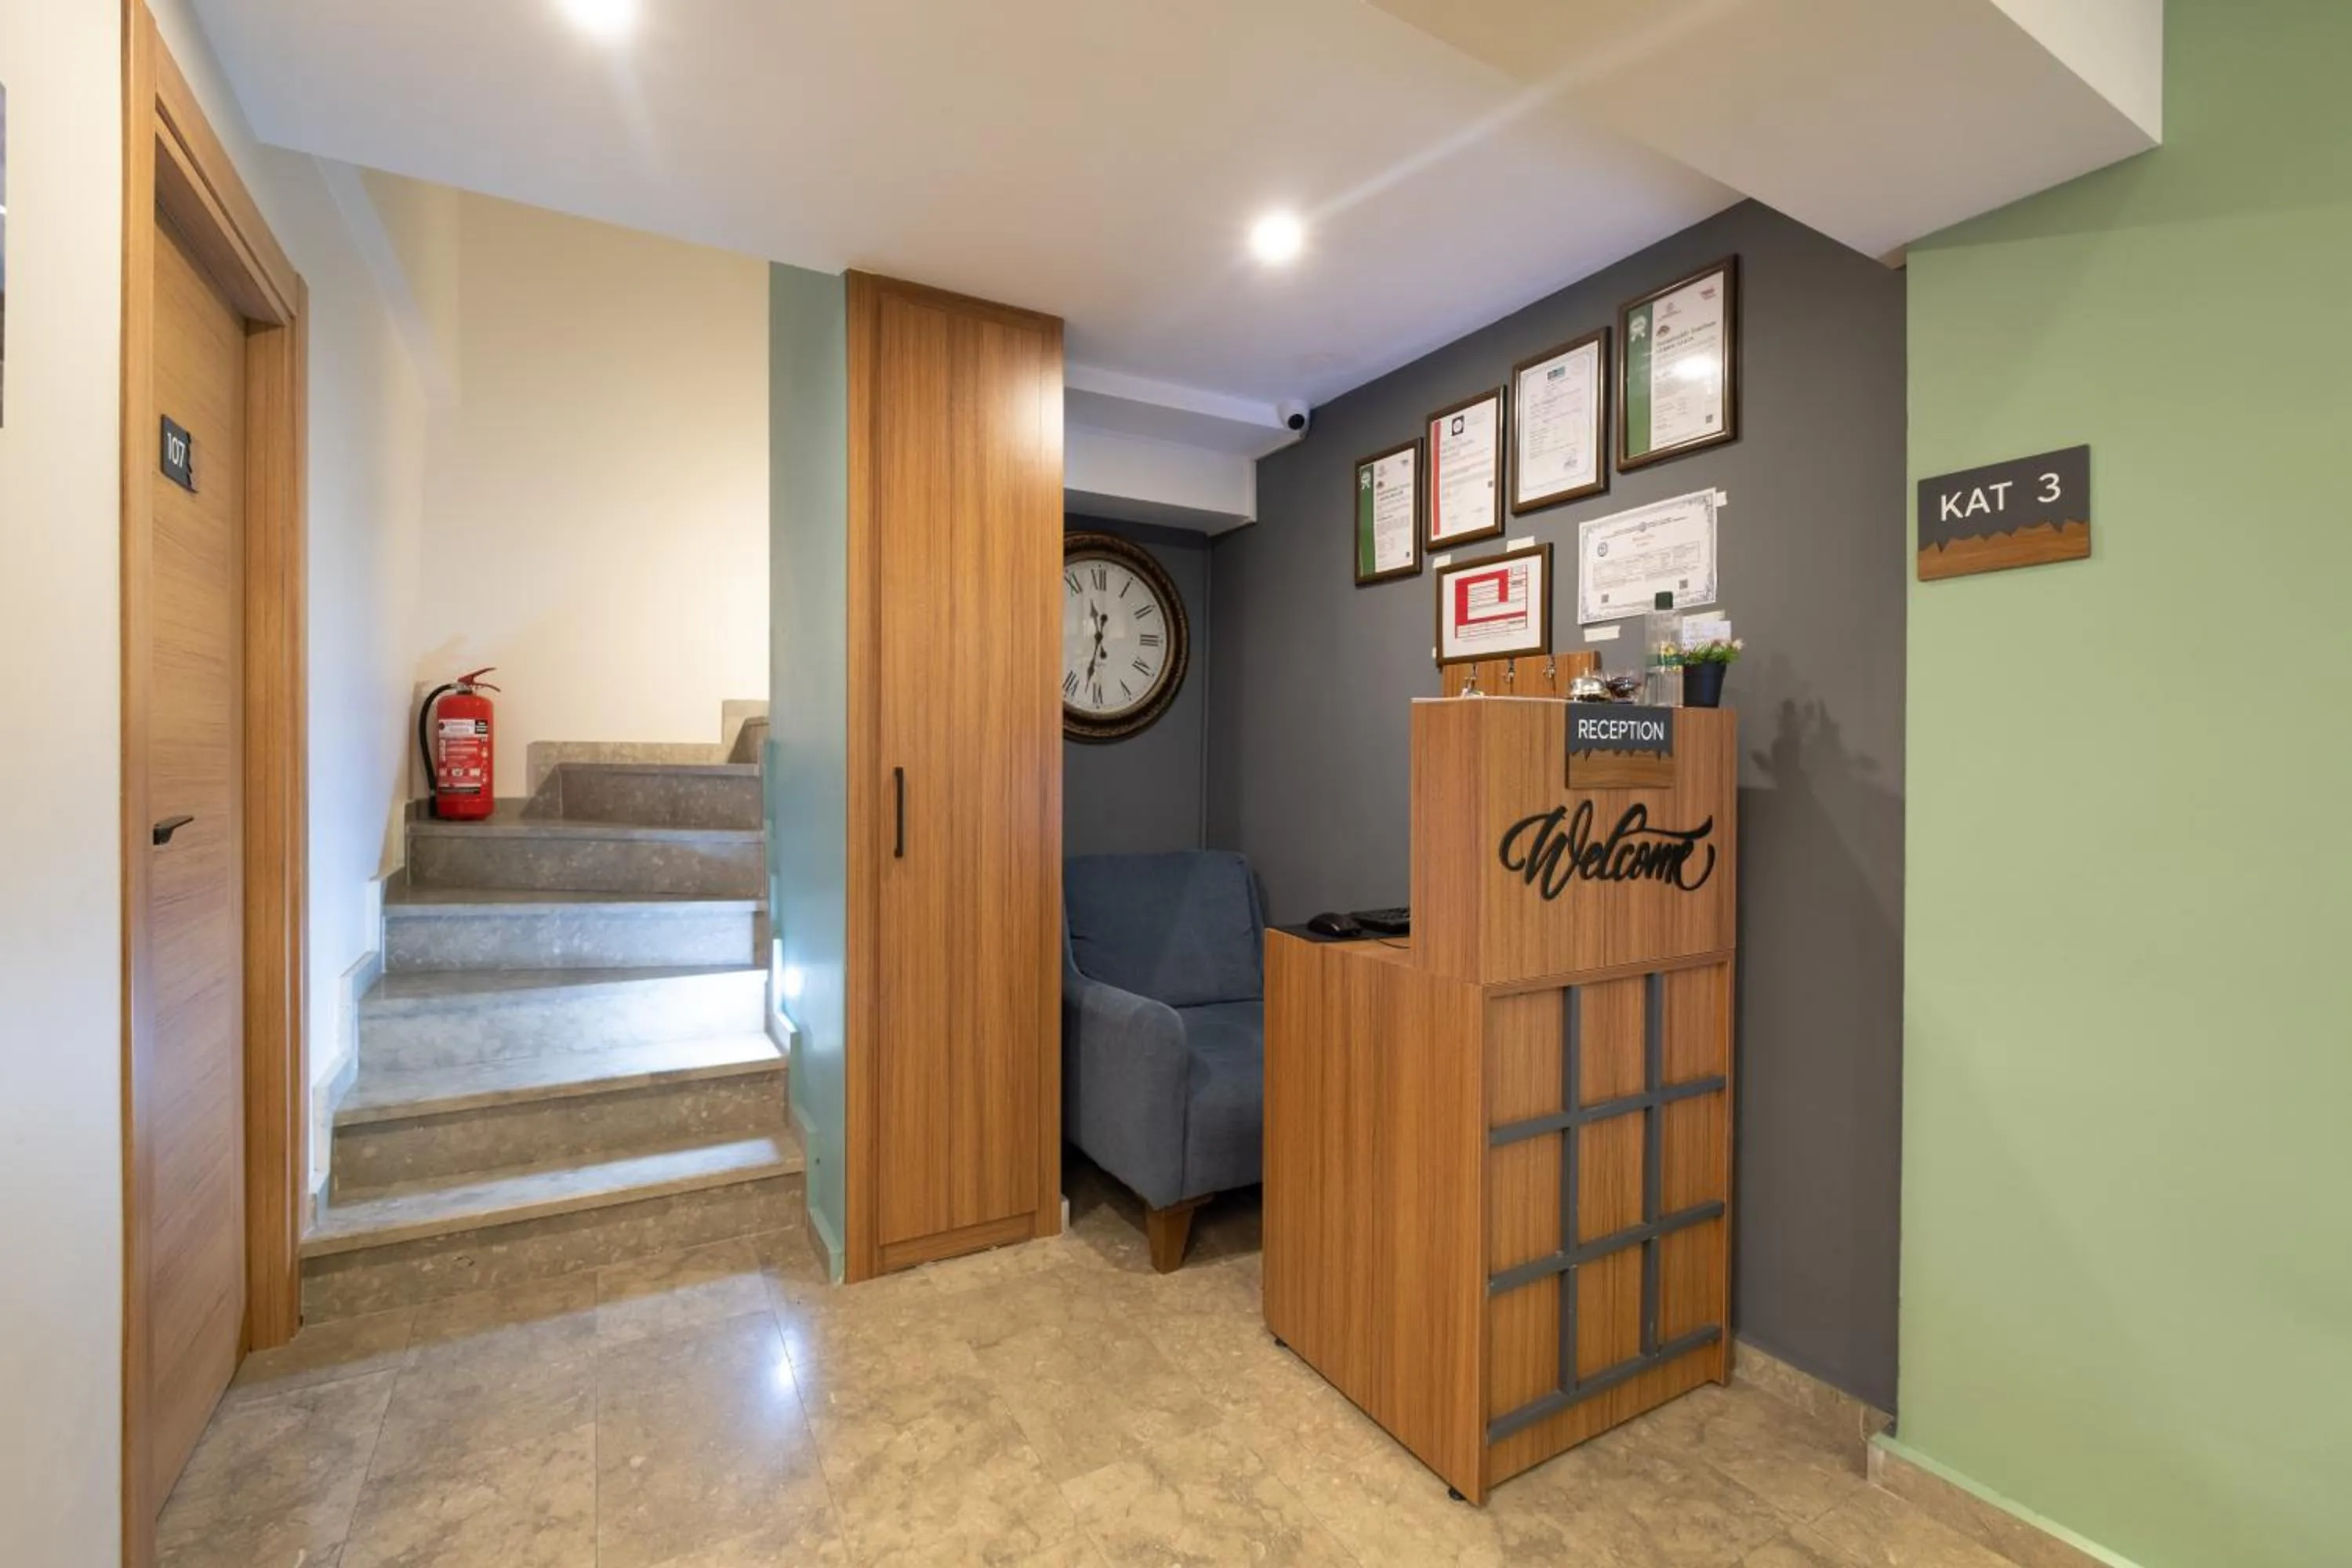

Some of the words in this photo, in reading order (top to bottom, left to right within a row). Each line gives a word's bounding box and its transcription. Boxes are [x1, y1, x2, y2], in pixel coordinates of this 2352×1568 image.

[167, 432, 186, 468] 107
[1940, 481, 2013, 521] KAT
[2037, 473, 2062, 503] 3
[1578, 719, 1664, 741] RECEPTION
[1498, 799, 1716, 901] Welcome
